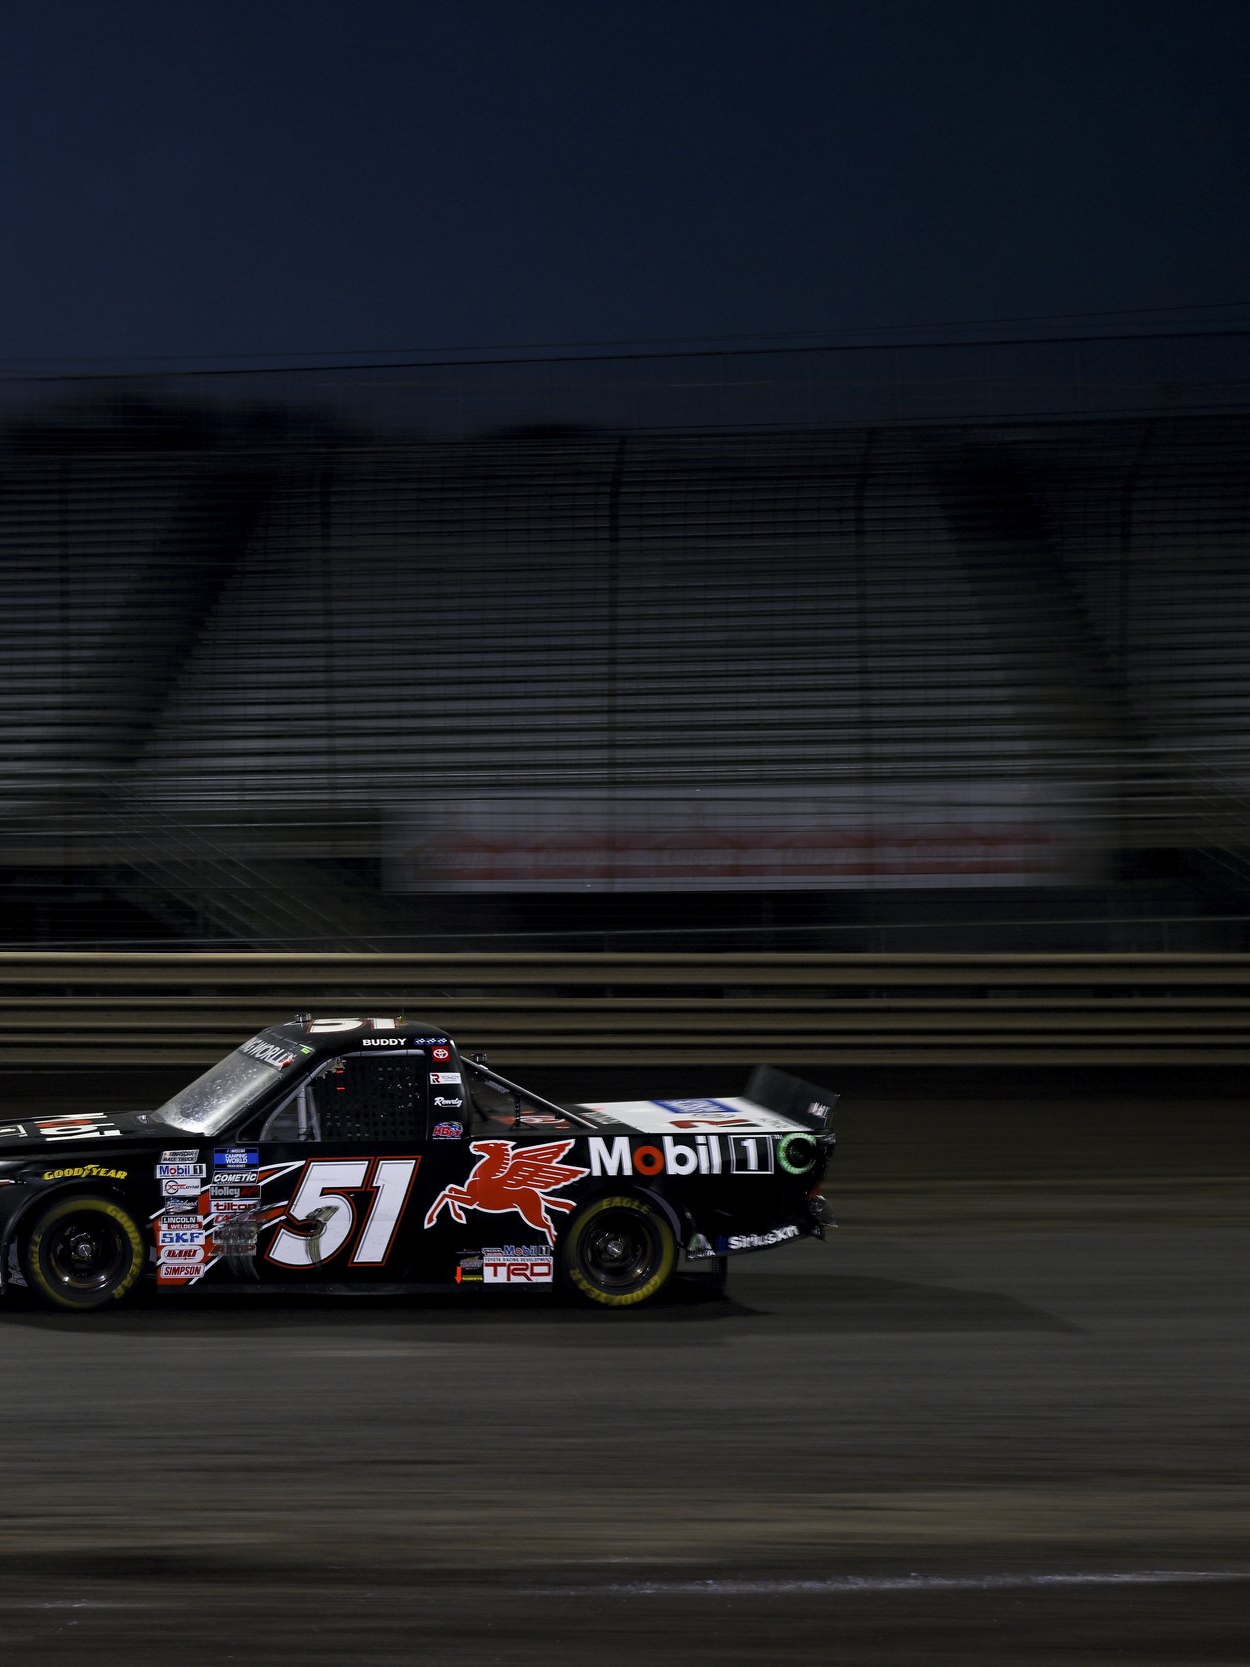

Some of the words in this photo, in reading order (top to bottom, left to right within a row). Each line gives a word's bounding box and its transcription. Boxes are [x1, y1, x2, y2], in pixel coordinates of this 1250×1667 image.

[588, 1135, 722, 1177] Mobil
[43, 1164, 128, 1180] GOODYEAR
[160, 1165, 191, 1175] Mobil
[214, 1172, 257, 1182] COMETIC
[211, 1187, 240, 1198] Holley
[265, 1157, 419, 1268] 51
[161, 1232, 204, 1244] SKF
[503, 1244, 538, 1256] Mobil
[164, 1266, 201, 1275] SIMPSON
[485, 1263, 552, 1282] TRD
